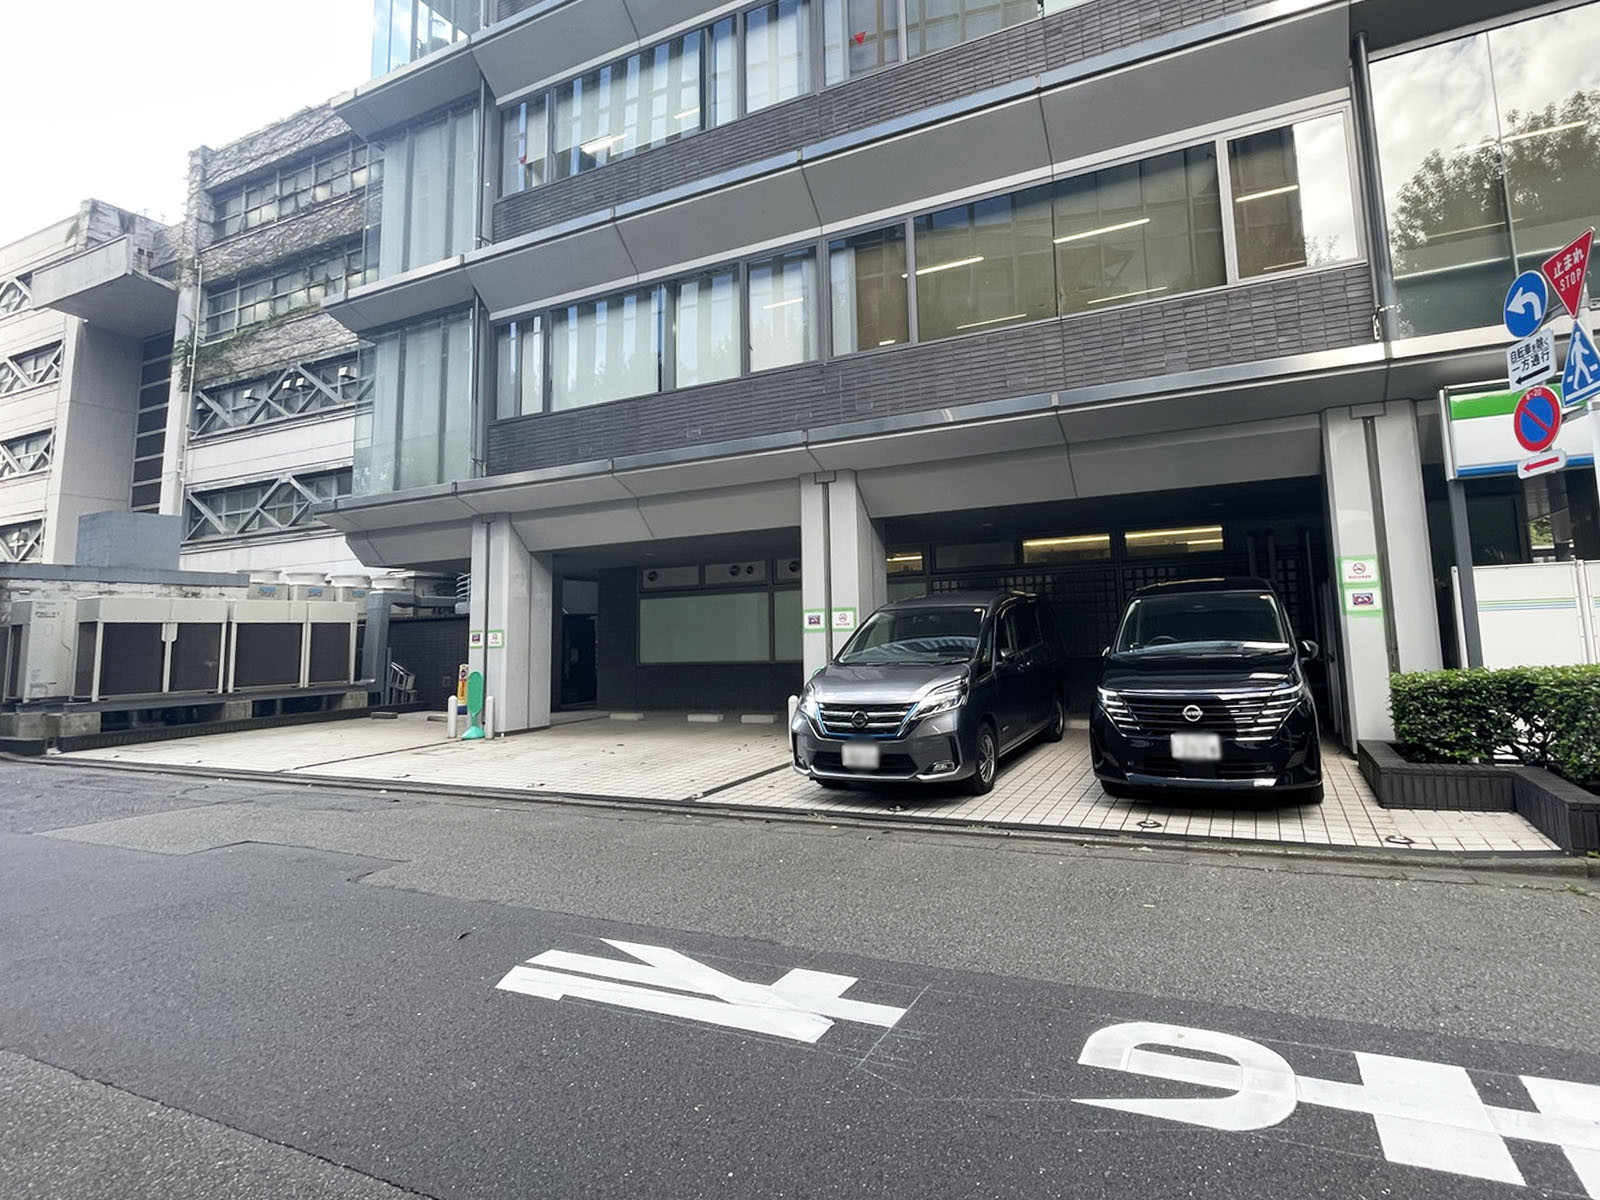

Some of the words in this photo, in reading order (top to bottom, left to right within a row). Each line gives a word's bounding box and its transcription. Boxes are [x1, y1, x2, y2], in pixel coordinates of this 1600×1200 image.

[1553, 247, 1585, 279] 止まれ
[1560, 268, 1581, 291] STOP
[1511, 336, 1550, 362] 自転車を除く
[1512, 351, 1550, 372] 一方通行
